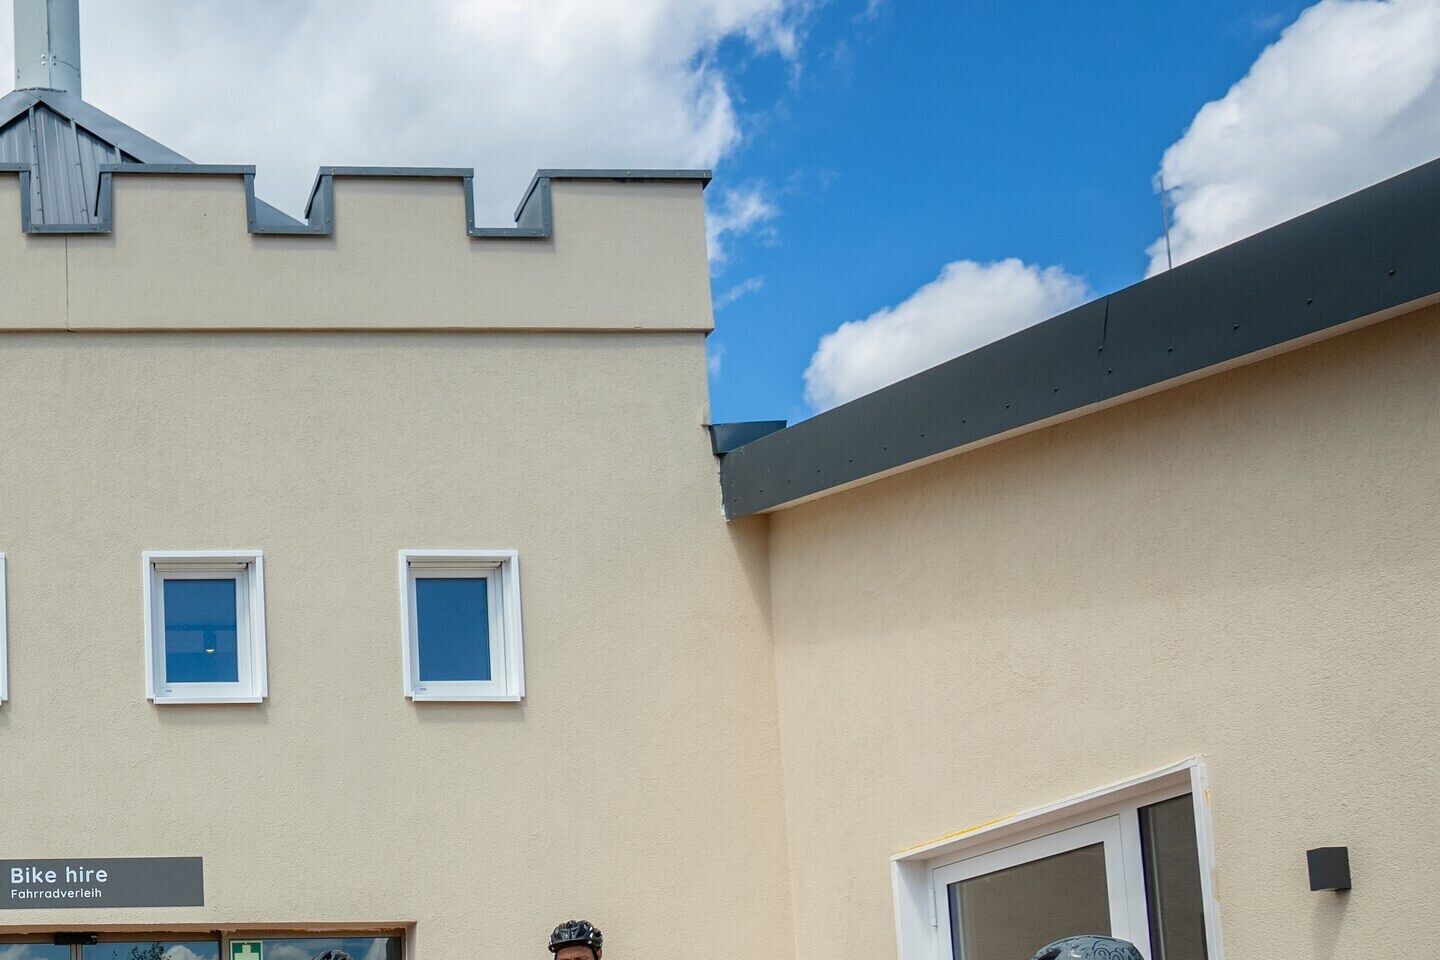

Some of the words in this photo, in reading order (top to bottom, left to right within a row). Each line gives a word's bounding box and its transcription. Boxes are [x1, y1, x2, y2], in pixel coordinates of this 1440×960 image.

[10, 867, 57, 884] Bike
[65, 866, 108, 883] hire
[11, 888, 103, 899] Fahrradverleih
